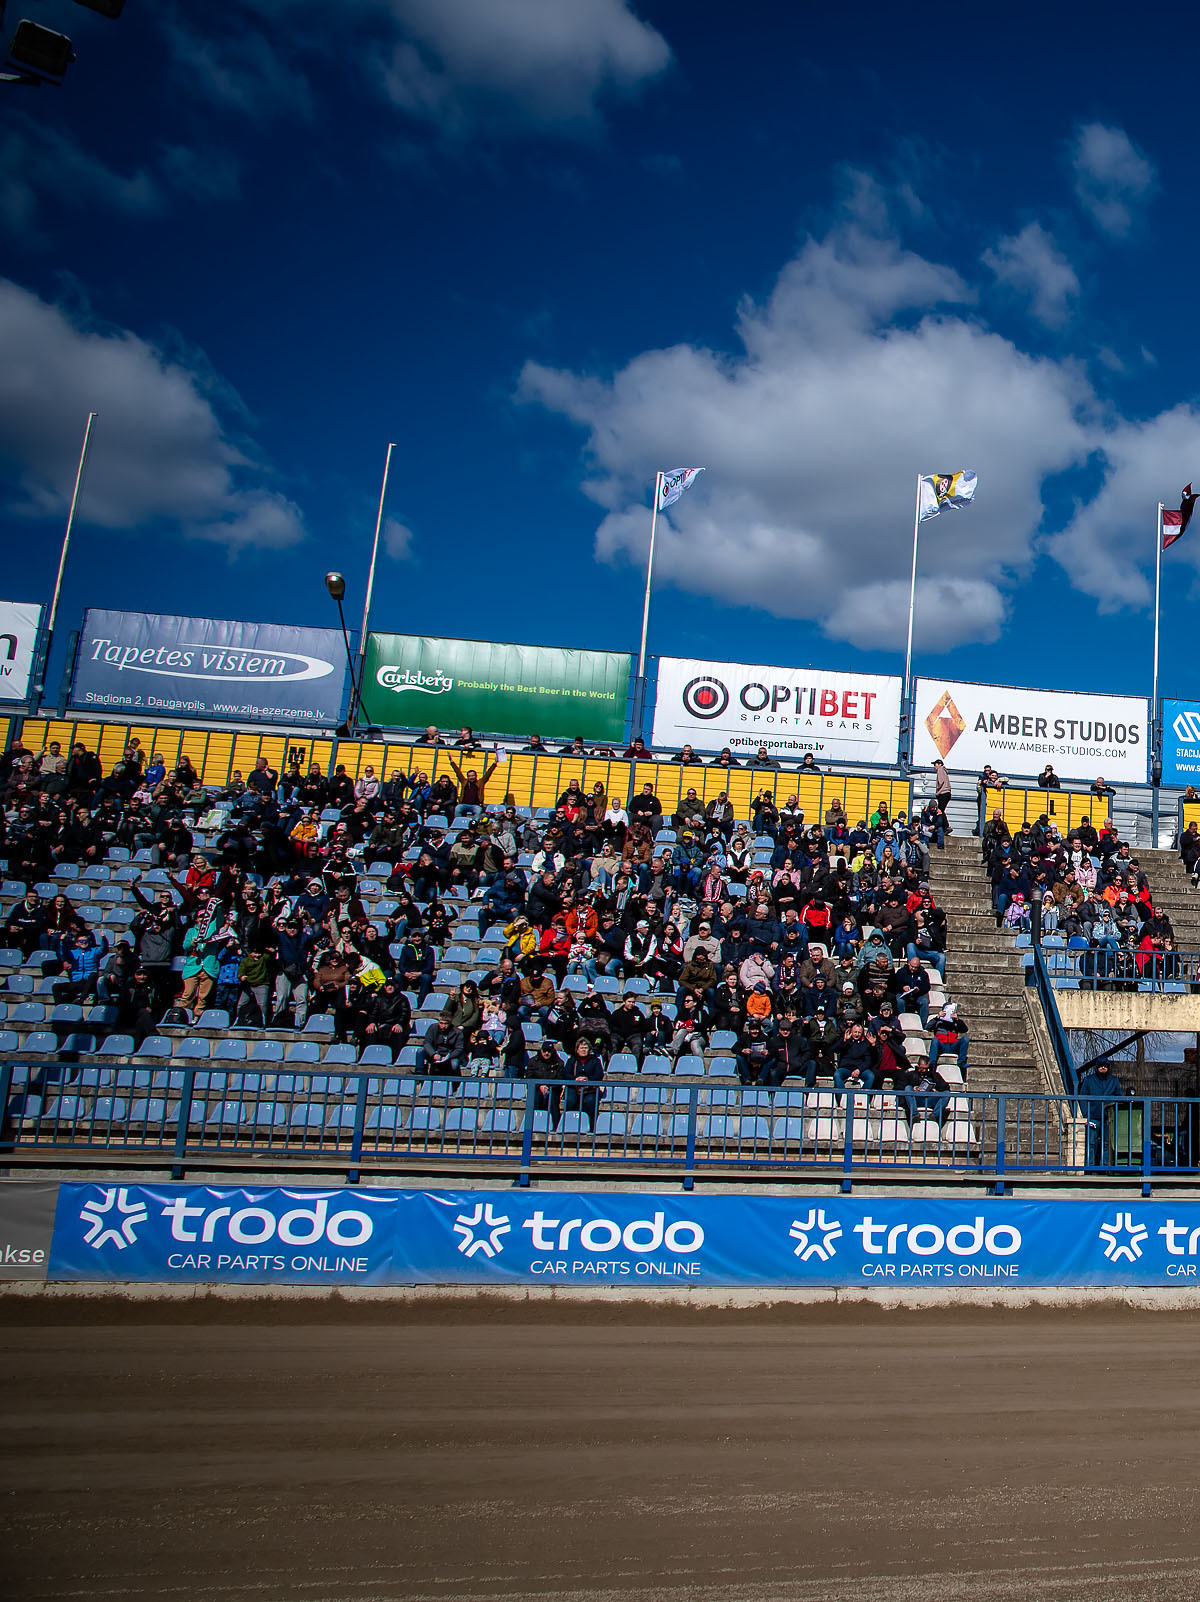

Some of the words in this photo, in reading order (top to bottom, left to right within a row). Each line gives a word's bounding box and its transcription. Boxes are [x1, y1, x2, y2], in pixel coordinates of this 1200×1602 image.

[91, 638, 195, 670] Tapetes
[201, 651, 287, 675] visiem
[376, 664, 454, 694] Carlsberg
[457, 680, 498, 692] Probably
[500, 683, 515, 691] the
[517, 684, 537, 693] Best
[539, 686, 560, 695] Beer
[562, 687, 570, 696] in
[572, 688, 587, 697] the
[589, 690, 615, 700] World
[85, 692, 132, 705] Stadiona
[134, 695, 145, 707] 2,
[147, 697, 206, 711] Daugavpils
[212, 702, 326, 719] www.zila-ezerzeme.lv
[740, 682, 876, 720] OPTIBET
[740, 713, 813, 726] SPORTA
[827, 719, 873, 731] BĀRS
[974, 712, 1047, 738] AMBER
[1053, 719, 1140, 745] STUDIOS
[729, 737, 825, 751] optibetsportabars.lv
[989, 739, 1127, 758] WWW.AMBER-STUDIOS.COM
[160, 1197, 374, 1246] trodo
[522, 1211, 705, 1253] trodo
[852, 1216, 1022, 1256] trodo
[0, 1244, 45, 1263] kse
[168, 1253, 210, 1270] CAR
[217, 1254, 285, 1270] PARTS
[291, 1255, 369, 1272] ONLINE
[530, 1260, 567, 1275] CAR
[572, 1261, 630, 1275] PARTS
[635, 1261, 701, 1275] ONLINE
[861, 1263, 895, 1277] CAR
[900, 1264, 954, 1277] PARTS
[958, 1264, 1019, 1277] ONLINE
[1166, 1264, 1197, 1276] CAR
